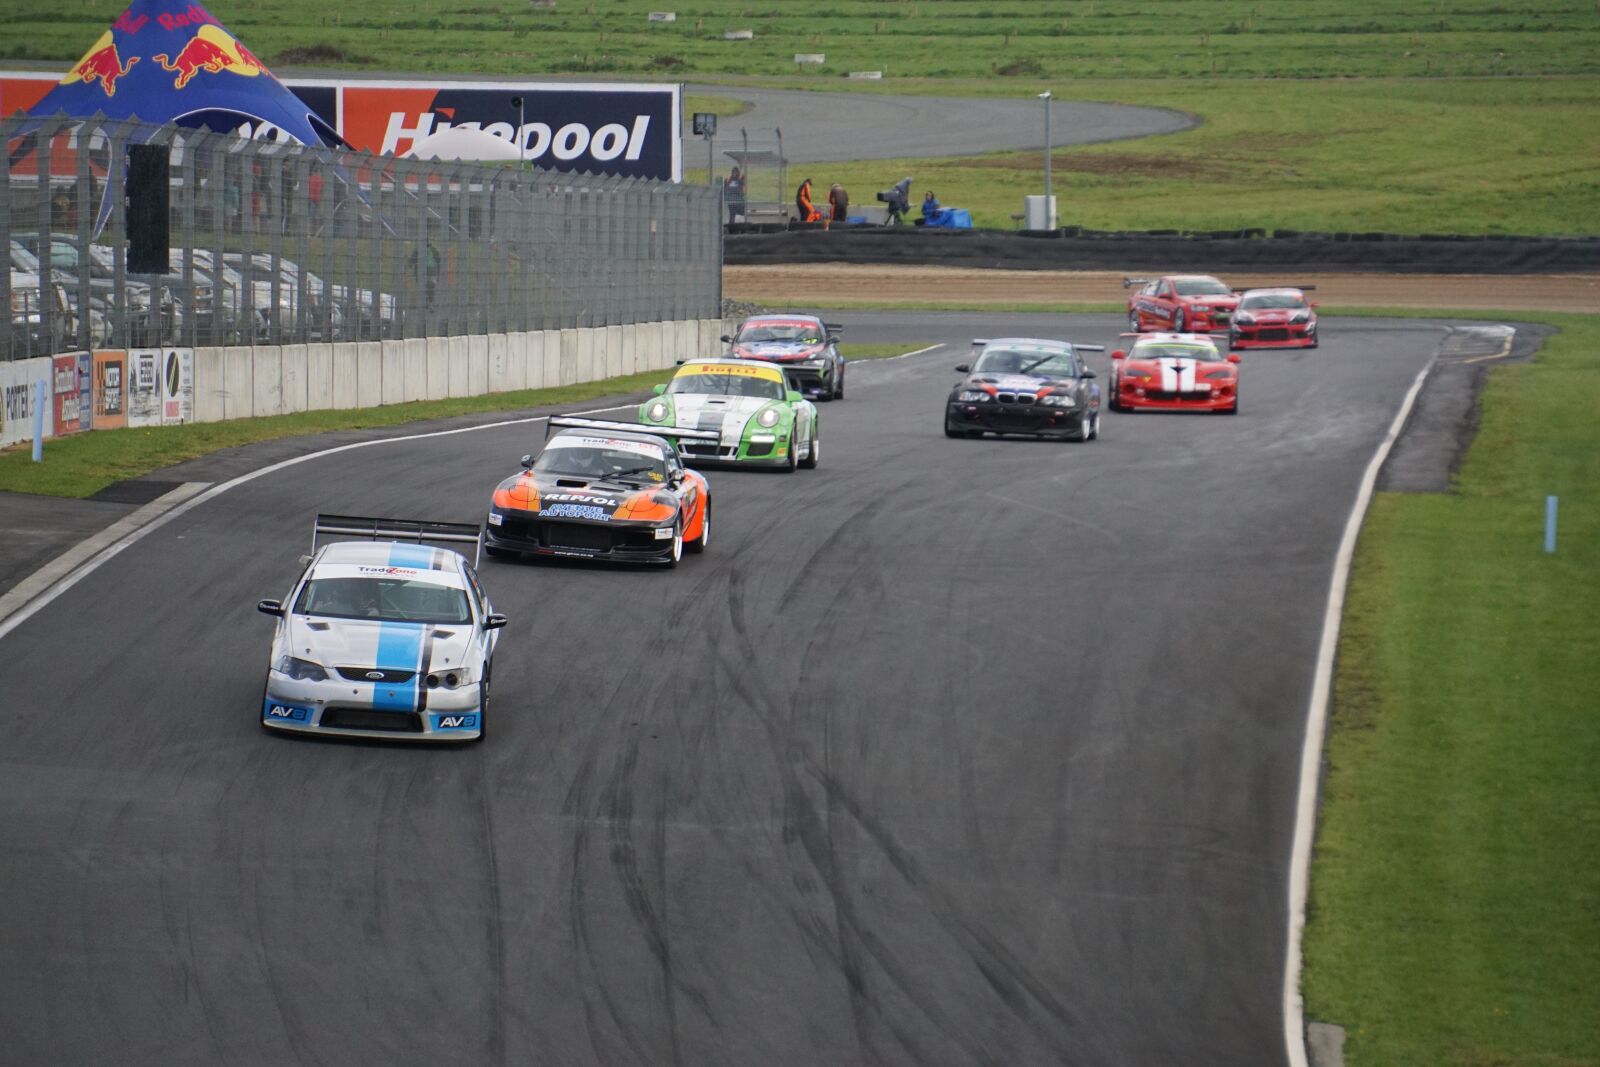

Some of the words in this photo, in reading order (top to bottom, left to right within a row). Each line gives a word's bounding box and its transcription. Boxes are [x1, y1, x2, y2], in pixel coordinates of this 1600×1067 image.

[380, 111, 650, 162] Hepool
[544, 493, 617, 506] REPSOL
[548, 503, 604, 514] AVENUE
